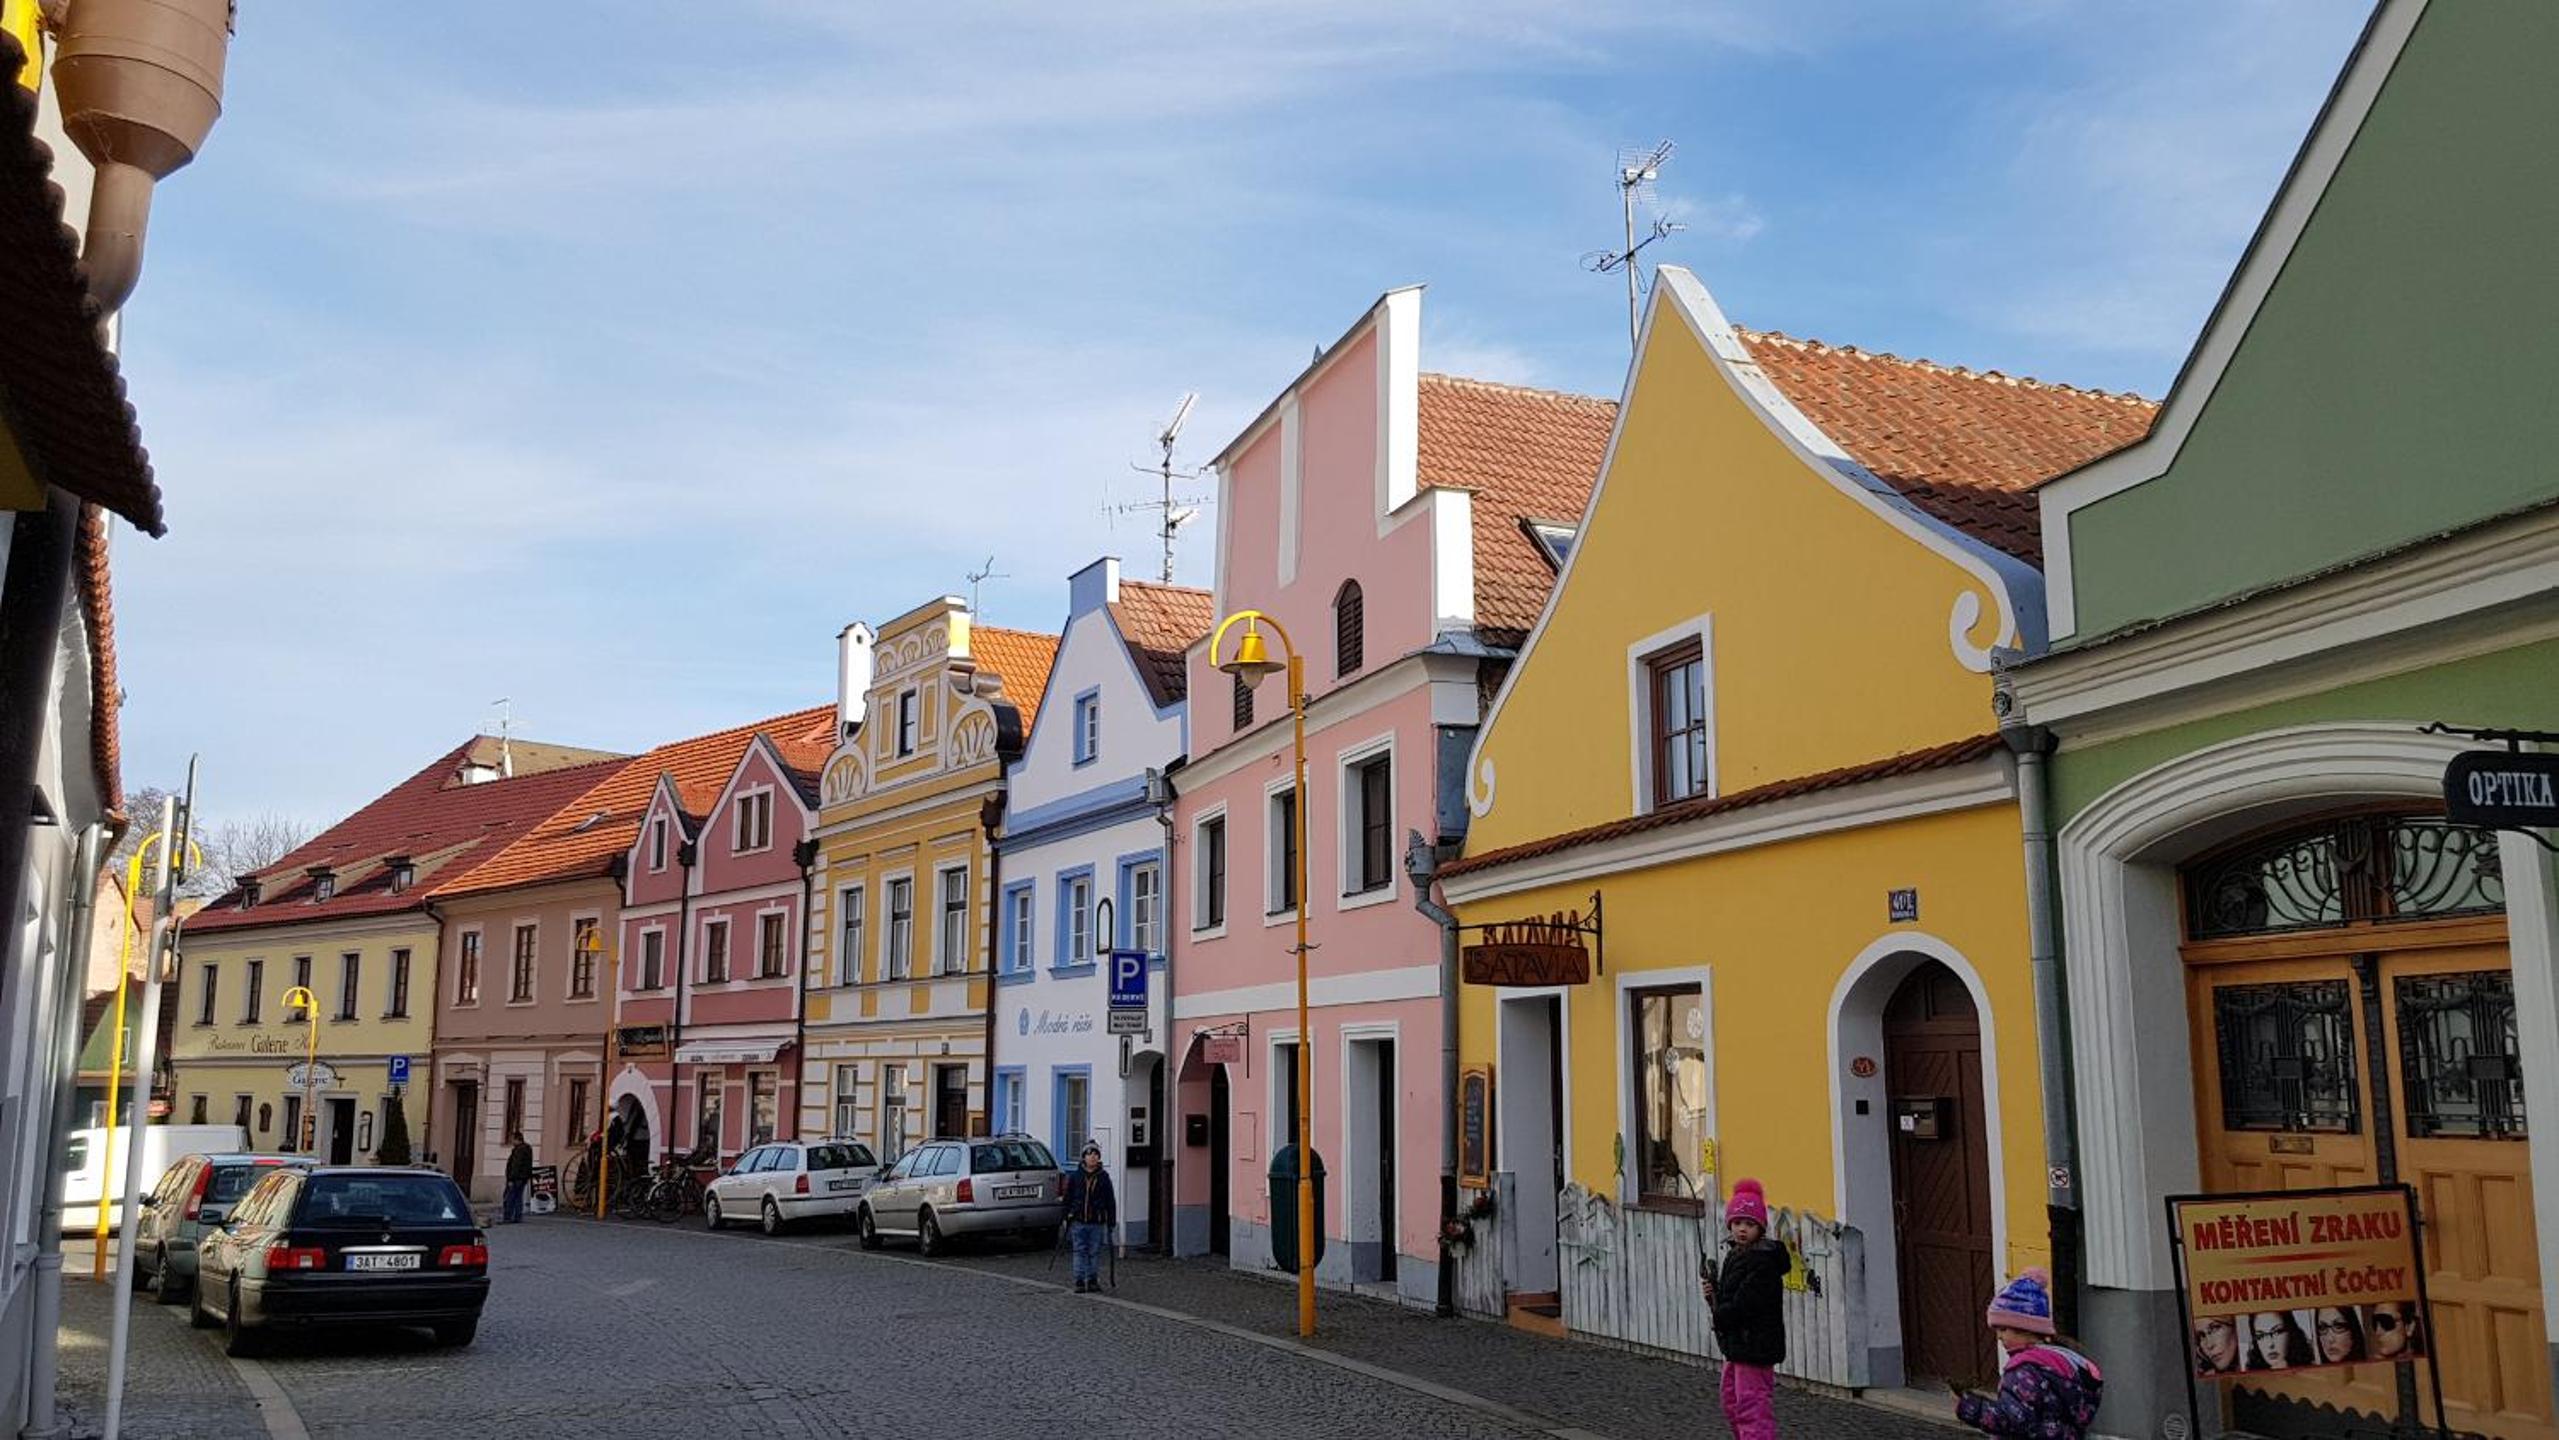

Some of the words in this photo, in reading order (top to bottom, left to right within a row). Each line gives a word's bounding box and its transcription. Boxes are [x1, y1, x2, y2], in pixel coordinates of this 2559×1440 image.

[2468, 770, 2556, 808] OPTIKA
[1118, 957, 1140, 990] P
[251, 1034, 289, 1053] Galerie
[393, 1058, 406, 1074] P
[2193, 1211, 2299, 1250] MĚŘENÍ
[2308, 1211, 2401, 1244] ZRAKU
[356, 1256, 377, 1268] 3AT
[2200, 1269, 2326, 1304] KONTAKTNÍ
[2334, 1265, 2405, 1294] ČOČKY
